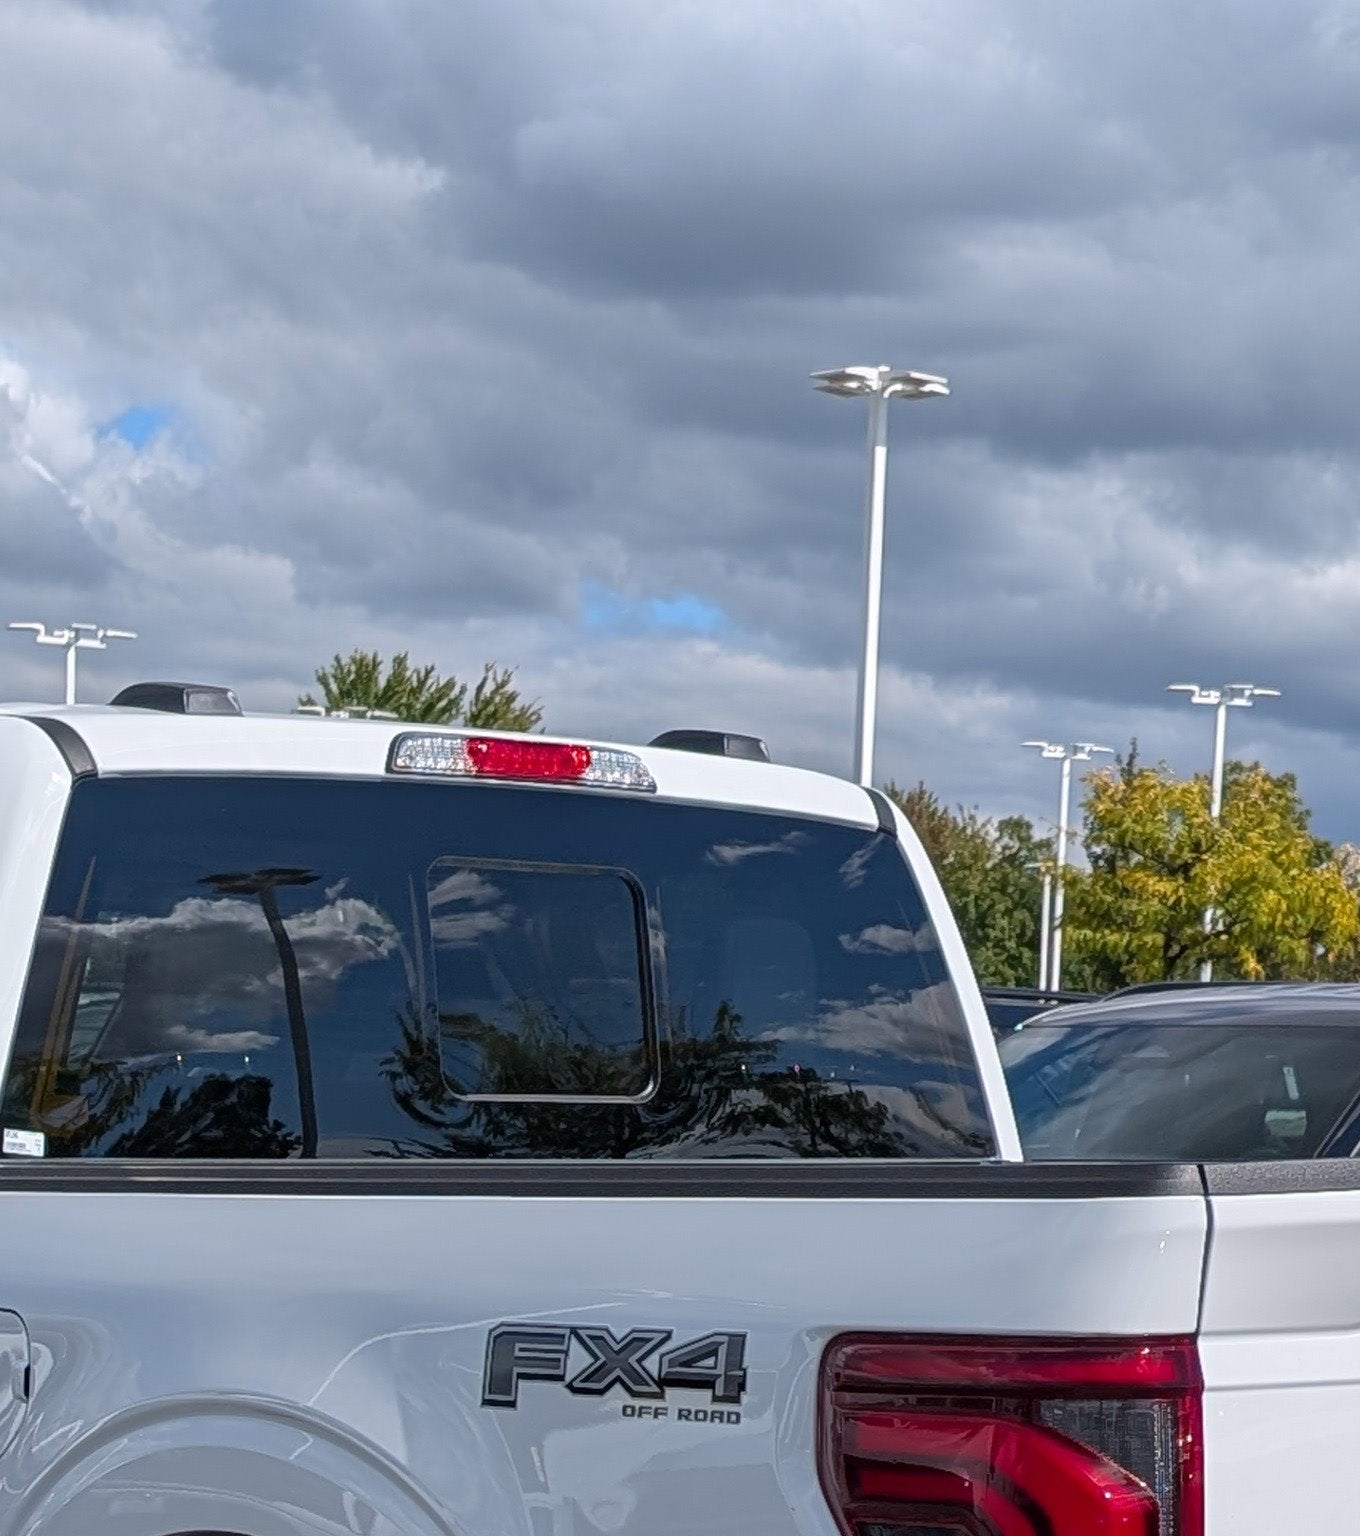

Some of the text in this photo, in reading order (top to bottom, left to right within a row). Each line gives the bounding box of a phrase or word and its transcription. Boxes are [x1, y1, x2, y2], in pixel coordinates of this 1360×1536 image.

[481, 1320, 748, 1408] FX4
[622, 1404, 742, 1425] OFF ROAD
